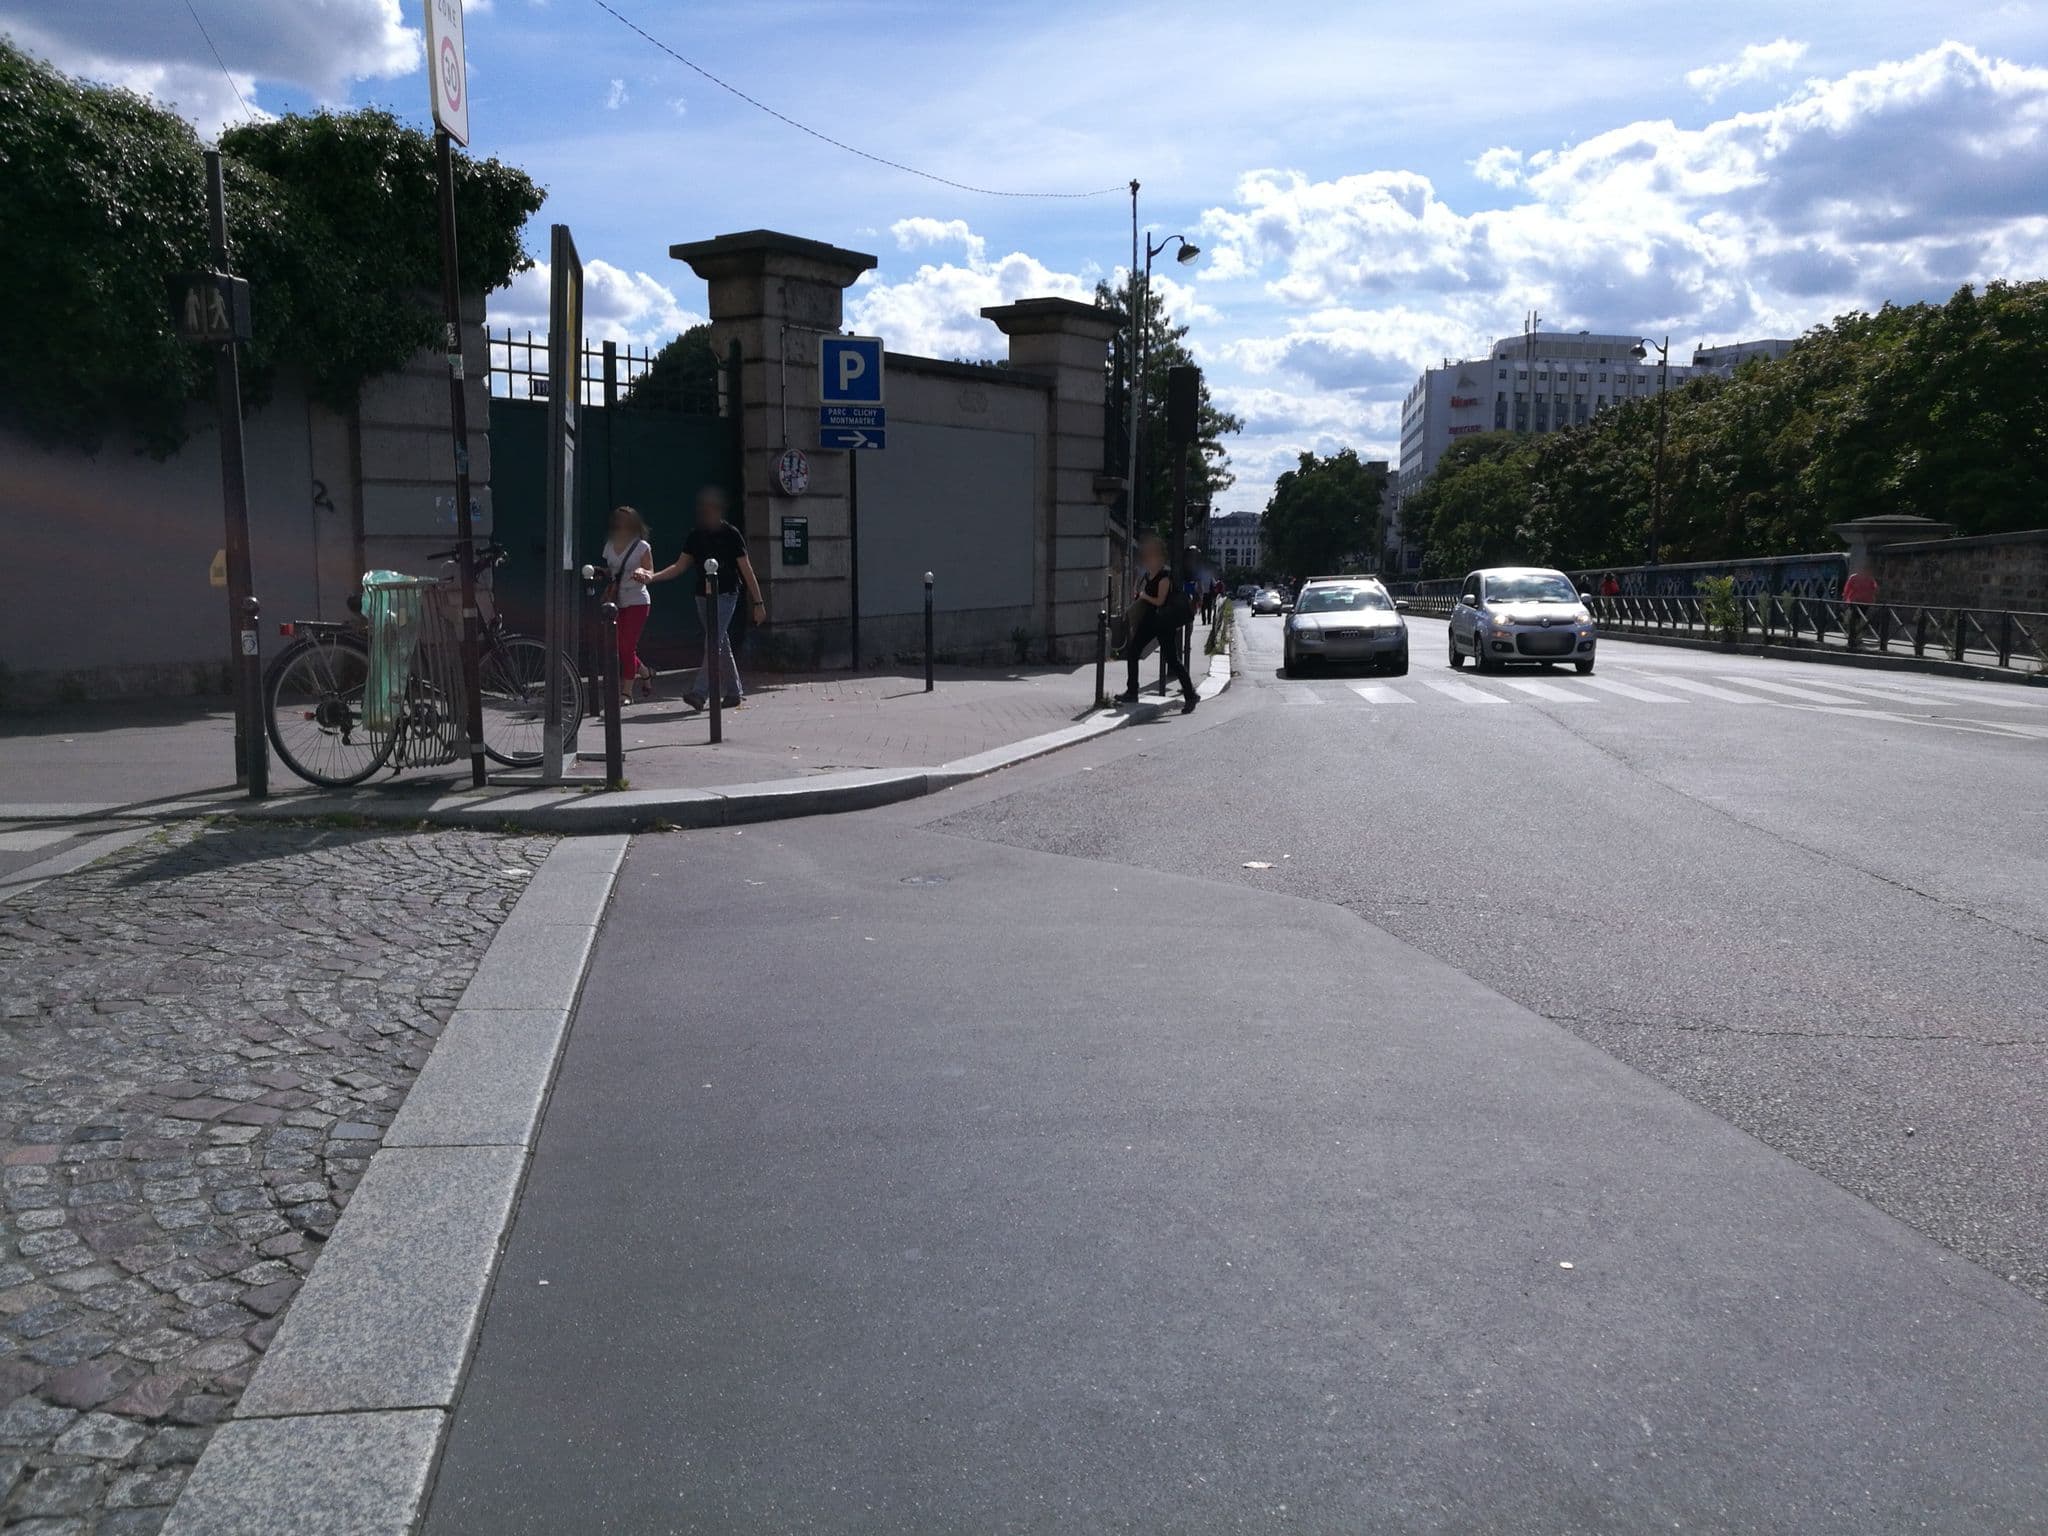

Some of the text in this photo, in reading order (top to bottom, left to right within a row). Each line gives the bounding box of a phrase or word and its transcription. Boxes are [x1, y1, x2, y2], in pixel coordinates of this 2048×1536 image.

[445, 56, 457, 92] 30
[839, 350, 866, 391] P
[828, 408, 878, 417] PARC CLICHY
[830, 417, 876, 425] MONTMARTRE
